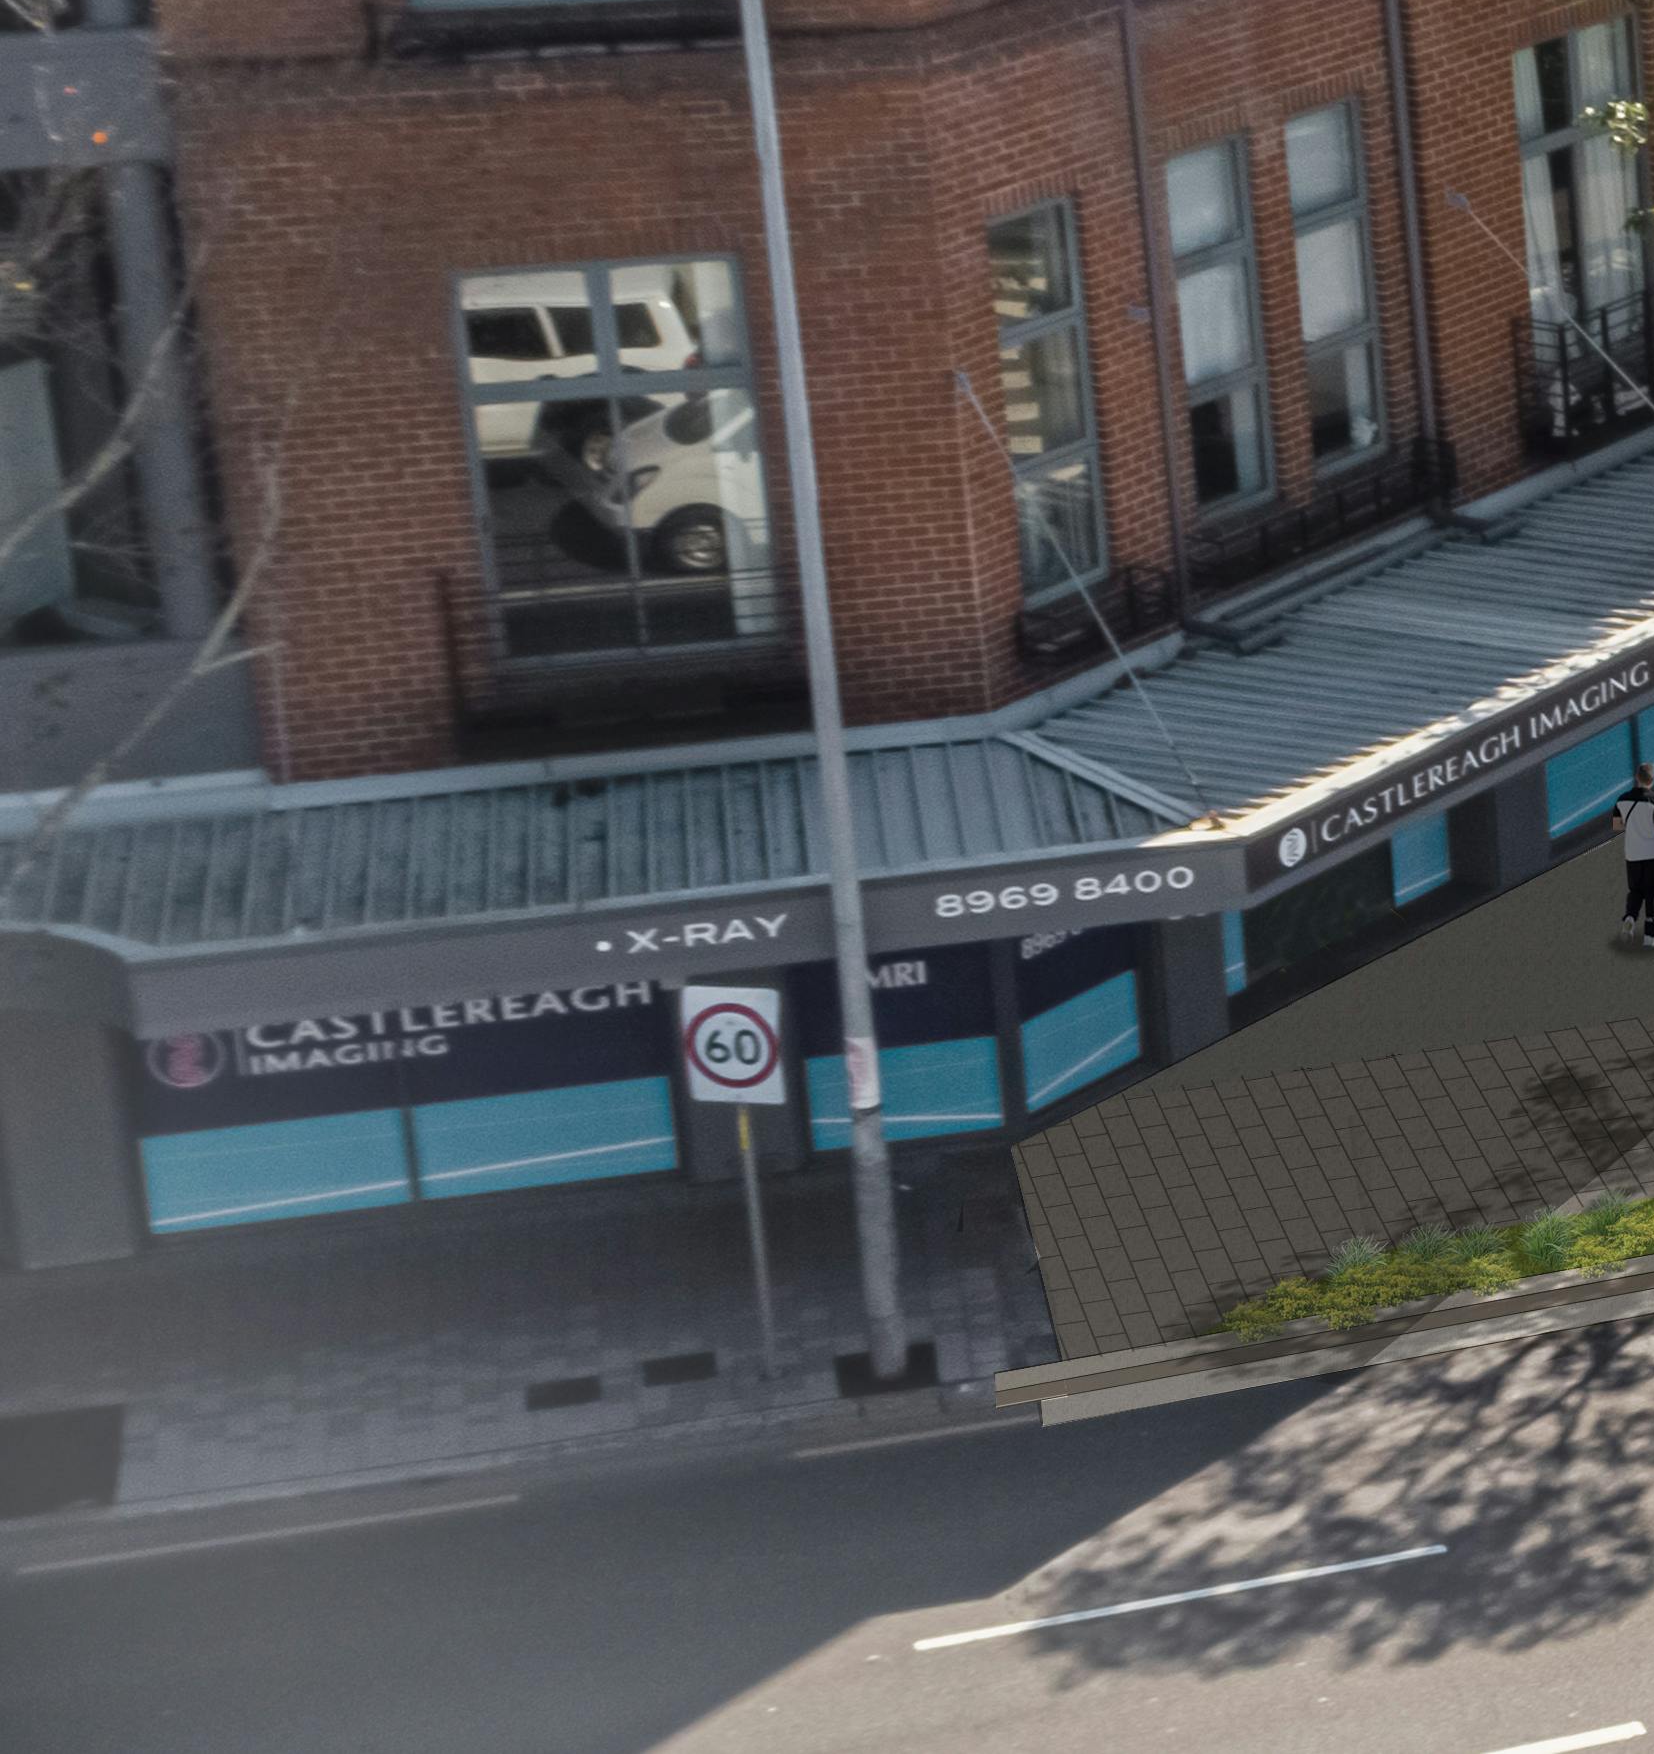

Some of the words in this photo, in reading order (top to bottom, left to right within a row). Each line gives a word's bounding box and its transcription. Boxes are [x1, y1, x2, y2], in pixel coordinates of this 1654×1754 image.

[1320, 725, 1522, 843] CASTLEREAGH
[1529, 660, 1651, 739] IMAGING
[935, 882, 1060, 918] 8969
[1073, 865, 1195, 901] 8400
[625, 913, 788, 953] X-RAY
[866, 960, 928, 989] MRI
[245, 979, 652, 1047] CASTLEREAGH
[249, 1034, 449, 1076] IMAGING
[704, 1029, 761, 1065] 60
